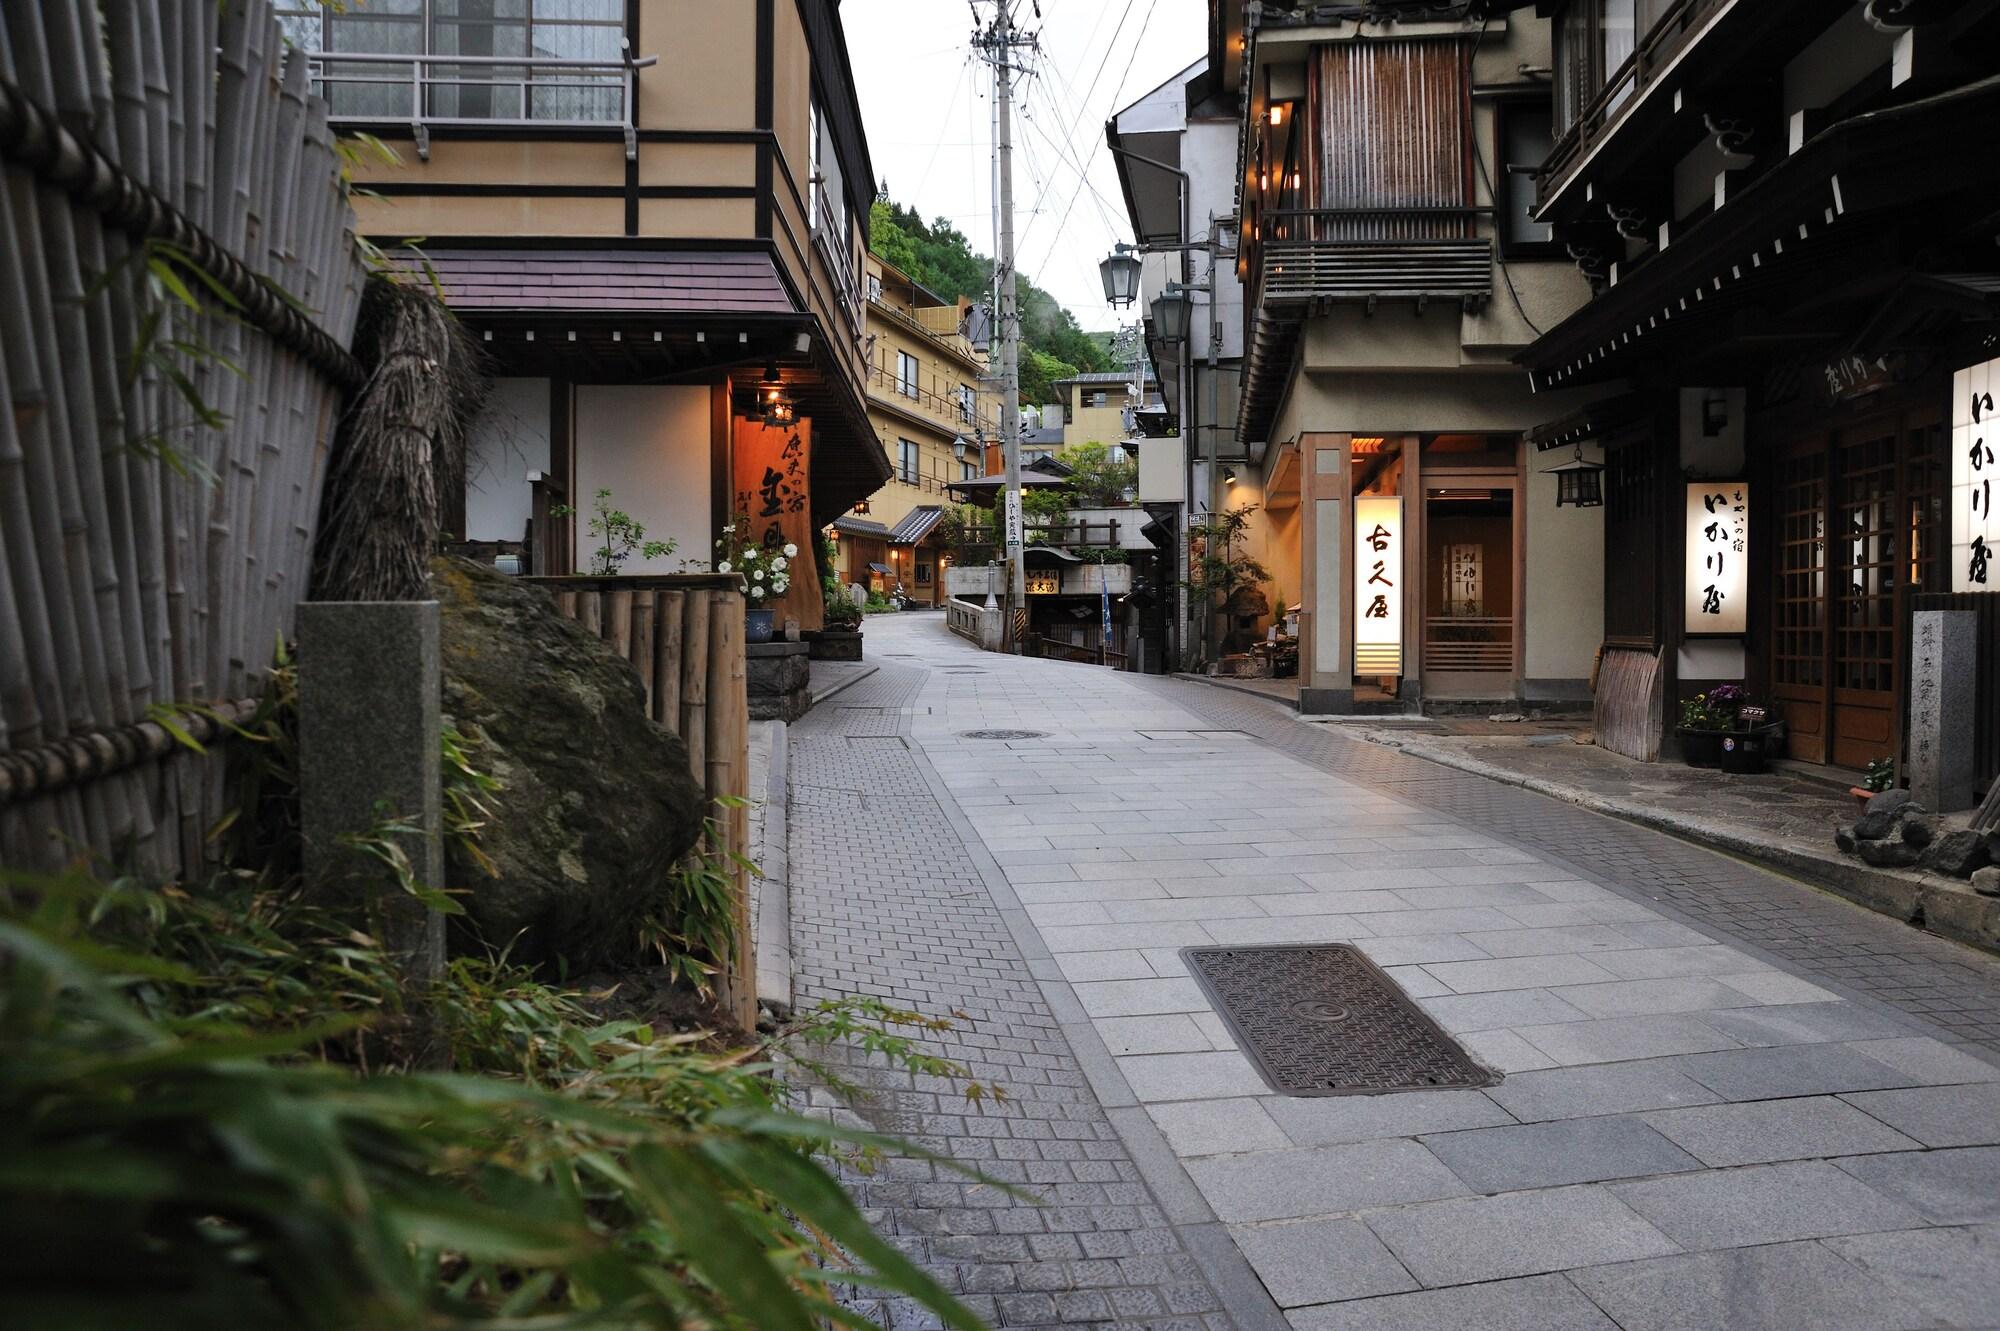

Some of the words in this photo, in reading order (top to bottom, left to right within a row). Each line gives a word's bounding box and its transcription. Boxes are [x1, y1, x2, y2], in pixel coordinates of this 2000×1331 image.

[1732, 490, 1745, 552] もやいの宿
[1969, 391, 1994, 584] いかり屋
[1366, 524, 1393, 618] 古久屋
[1702, 493, 1728, 614] いかり屋
[1741, 708, 1765, 716] コマクサ
